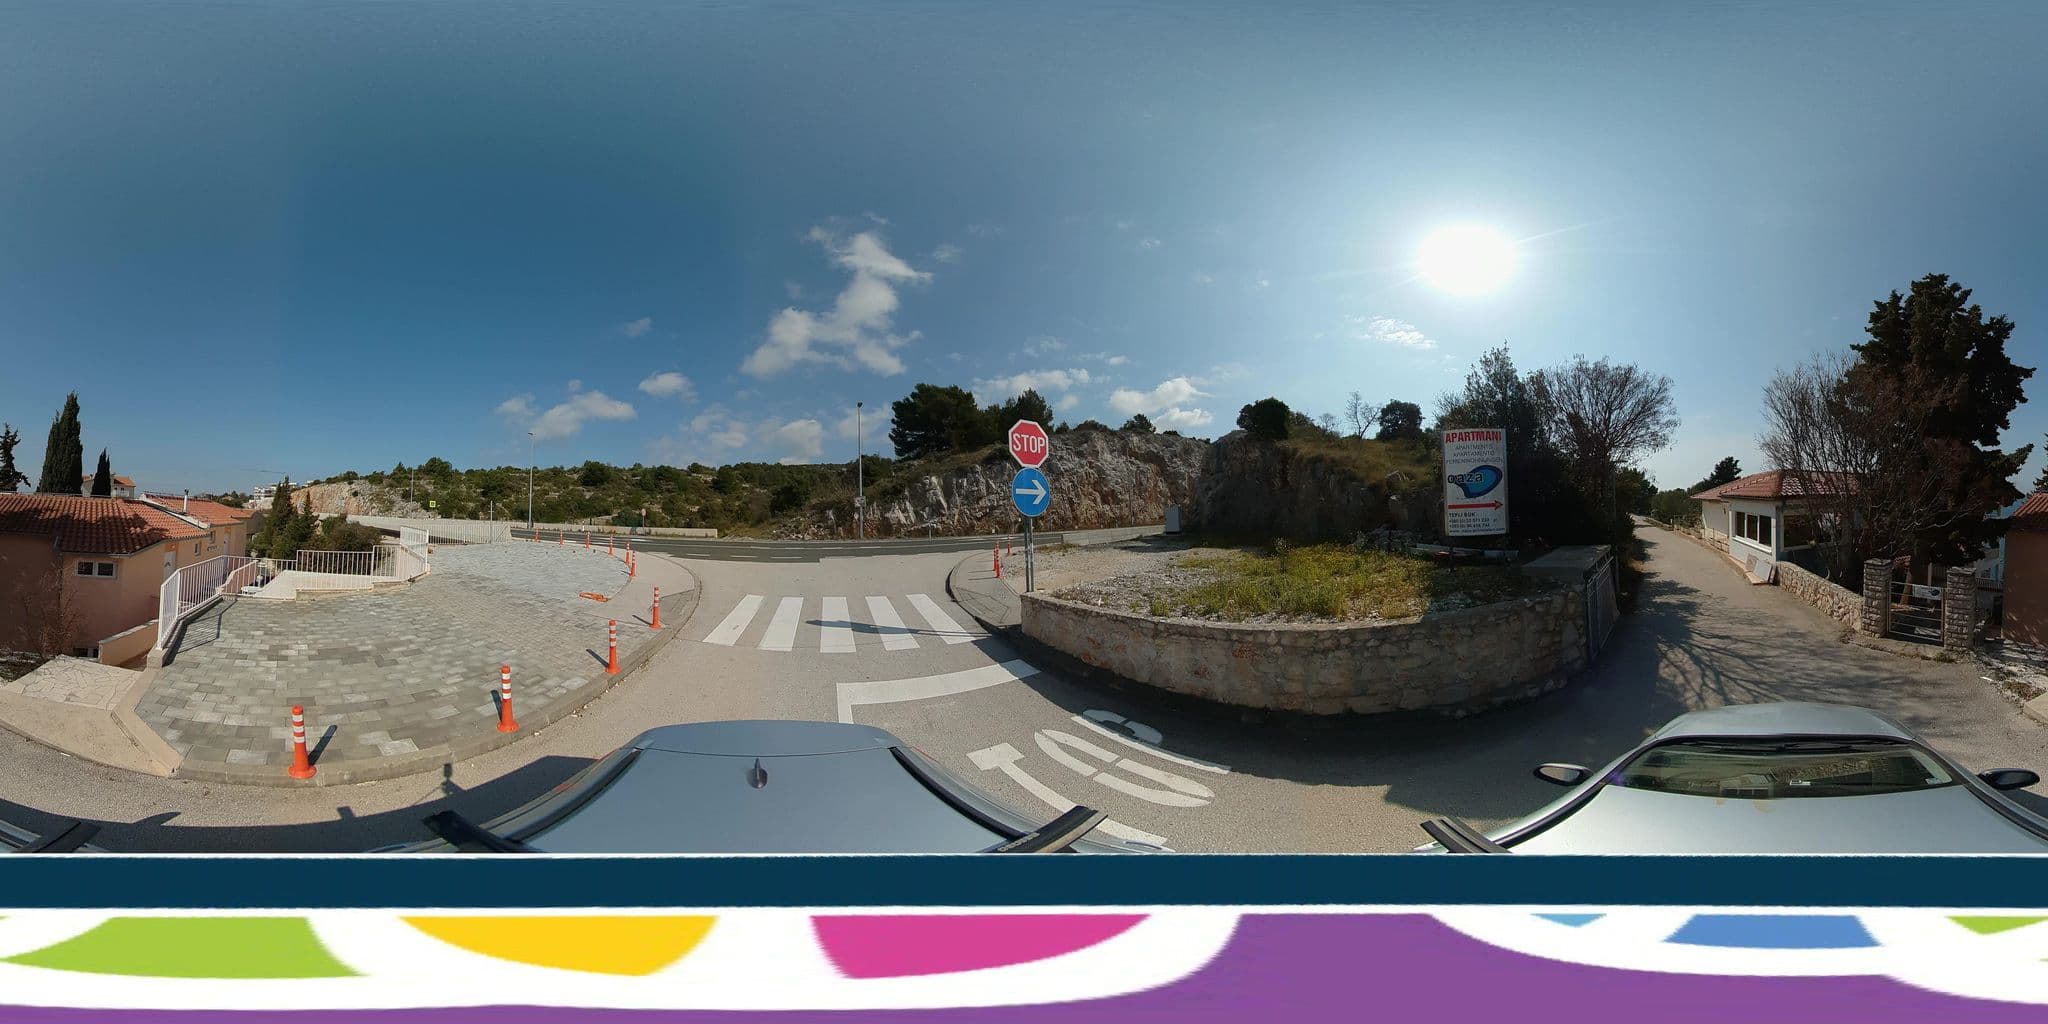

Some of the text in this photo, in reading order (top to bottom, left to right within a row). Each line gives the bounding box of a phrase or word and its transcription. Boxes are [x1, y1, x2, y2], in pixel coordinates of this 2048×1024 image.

[1012, 433, 1045, 454] STOP
[1445, 431, 1502, 444] APARTMANI
[1447, 473, 1483, 484] oaza
